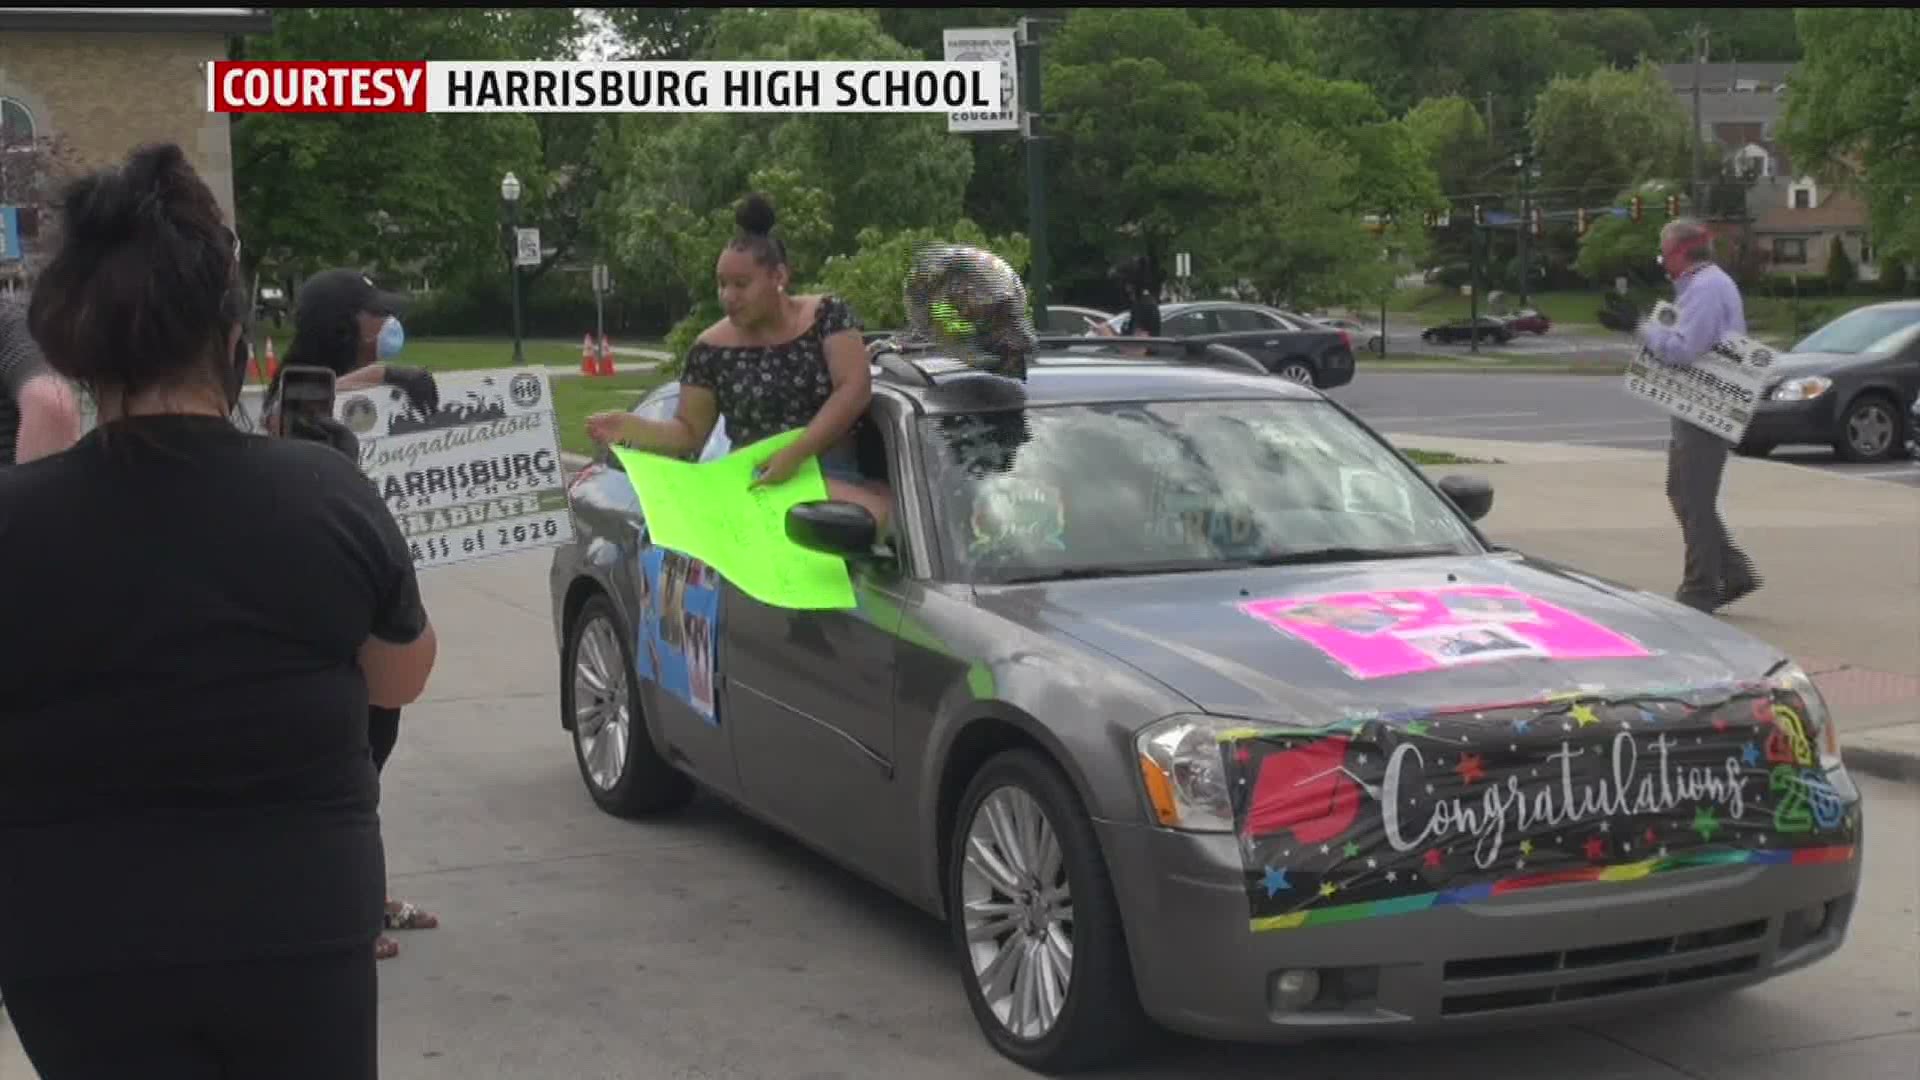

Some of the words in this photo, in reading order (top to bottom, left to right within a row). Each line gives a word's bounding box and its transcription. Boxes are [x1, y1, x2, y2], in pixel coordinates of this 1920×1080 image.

[383, 448, 556, 499] ARRISBURG
[411, 535, 449, 561] ASS
[462, 528, 485, 553] of
[498, 519, 558, 545] 2020
[1382, 731, 1748, 869] Congratulations
